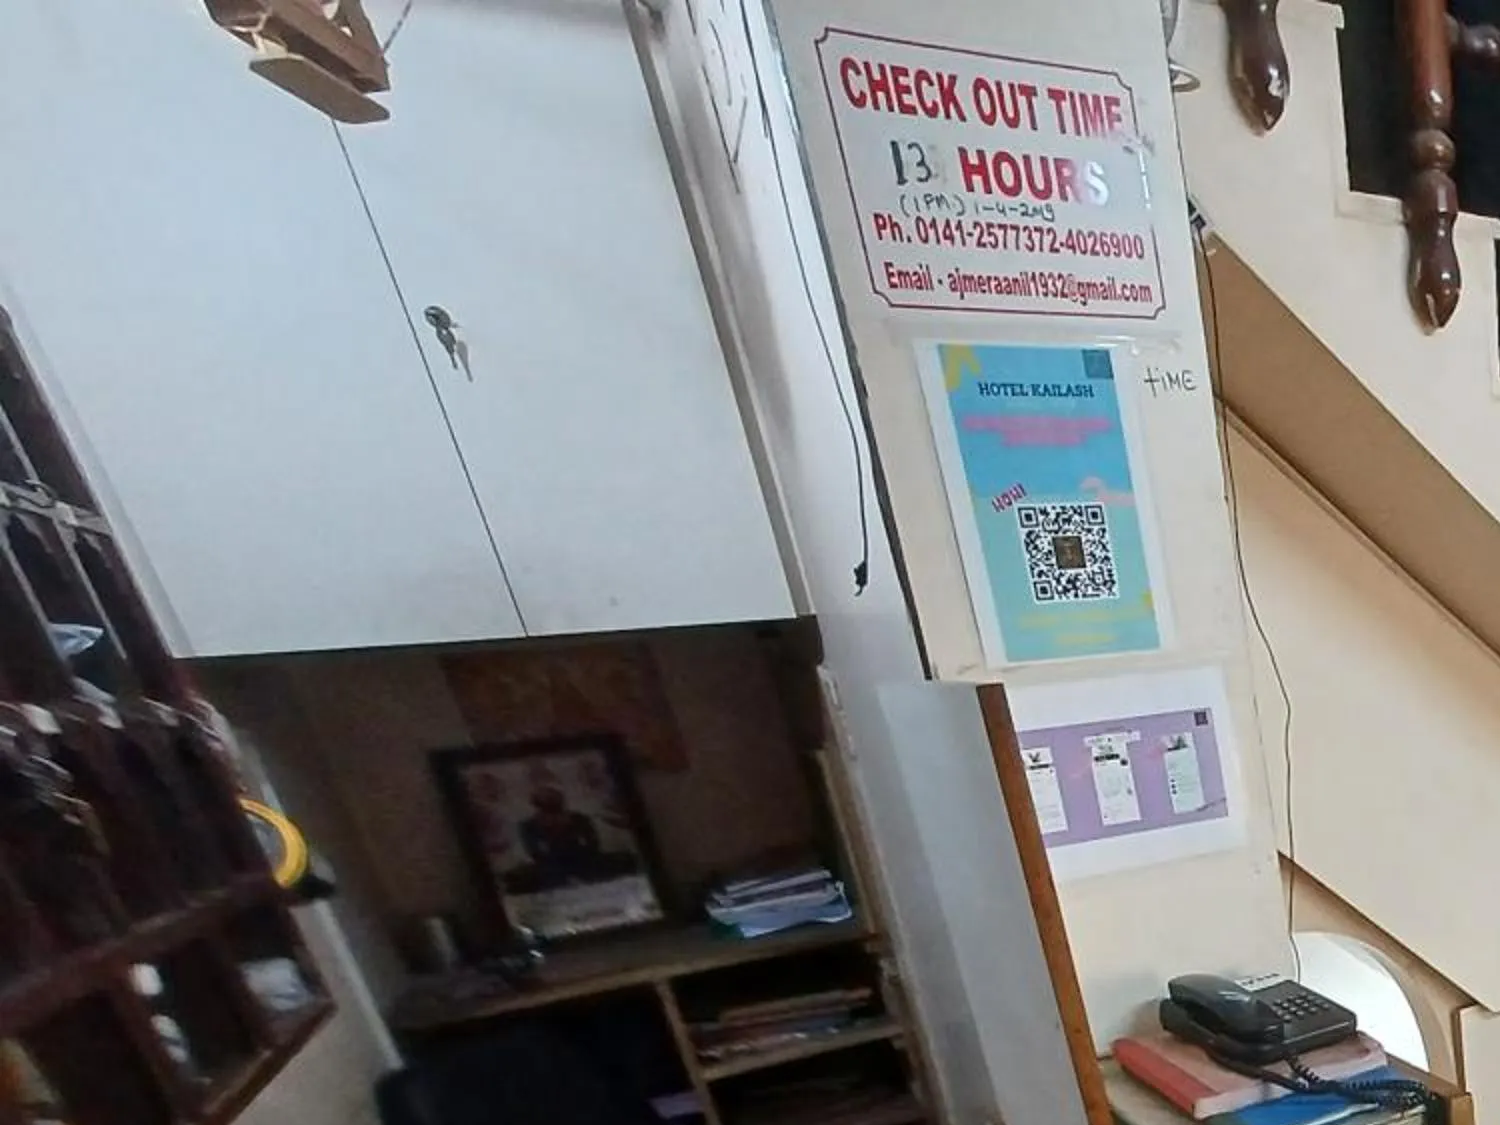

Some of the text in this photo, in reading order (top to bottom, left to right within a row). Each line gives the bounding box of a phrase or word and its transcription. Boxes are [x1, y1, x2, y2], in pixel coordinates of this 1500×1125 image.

[839, 56, 1123, 137] CHECK OUT TIME
[957, 146, 1110, 206] HOURS
[873, 212, 1146, 259] Ph. 0141-2577372-4026900
[884, 262, 935, 291] Email
[947, 268, 1153, 305] ajmeraanil1932@gmail.com
[978, 382, 1095, 398] HOTEL KAILASH
